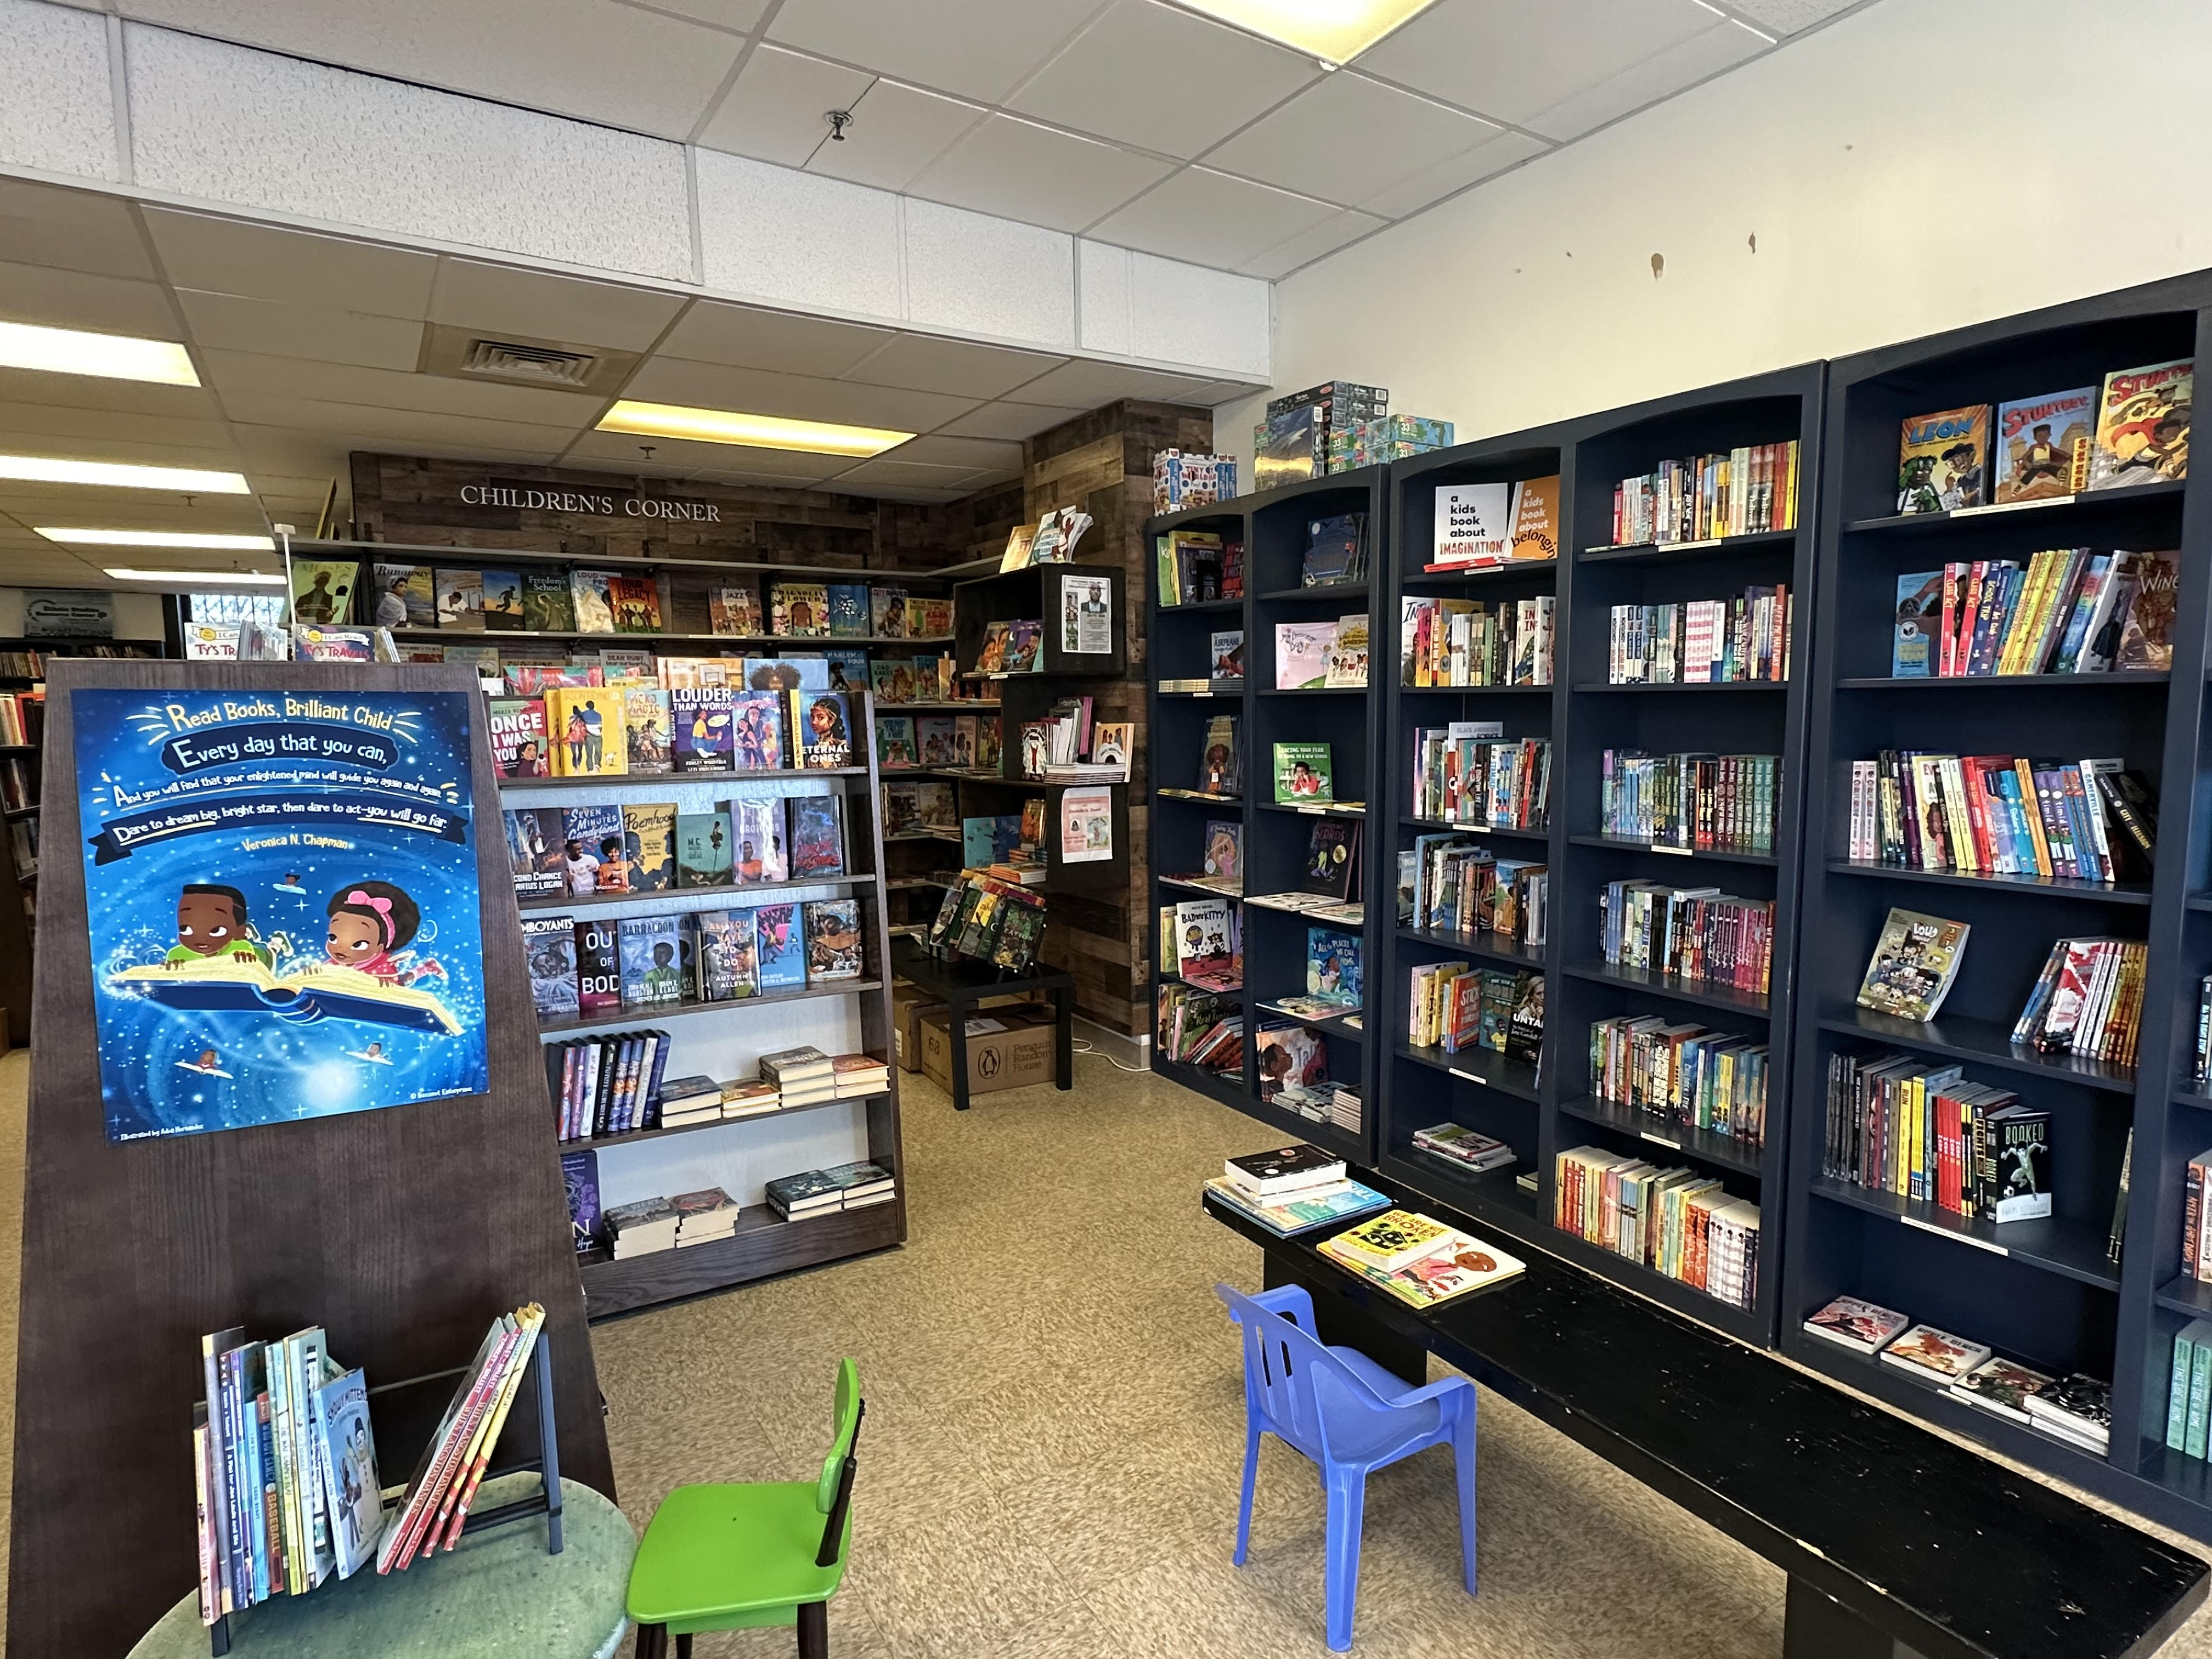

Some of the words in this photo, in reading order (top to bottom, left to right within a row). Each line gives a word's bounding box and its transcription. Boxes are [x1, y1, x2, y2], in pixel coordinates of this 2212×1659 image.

[1401, 423, 1410, 432] 33
[1908, 416, 1974, 445] LEON
[1333, 438, 1341, 448] 33
[1331, 463, 1340, 472] 33
[460, 485, 613, 515] CHILDREN'S
[625, 499, 721, 523] CORNER
[1451, 504, 1476, 514] kids
[1523, 497, 1544, 509] kids
[1450, 516, 1480, 526] book
[1521, 508, 1545, 520] book
[1450, 528, 1486, 538] about
[1519, 520, 1549, 532] about
[376, 565, 431, 578] Runaway
[533, 583, 562, 591] School
[620, 578, 643, 589] YOUR
[617, 588, 651, 603] LEGACY
[1983, 580, 1996, 603] SCHOOL
[1944, 597, 1954, 609] ACT
[1967, 597, 1976, 609] ACT
[1980, 605, 1991, 621] TRIP
[329, 645, 370, 658] TRAVELS
[672, 689, 732, 702] LOUDER
[673, 703, 698, 711] THAN
[699, 702, 732, 711] WORDS
[166, 704, 222, 731] Read
[223, 699, 280, 720] Books,
[285, 698, 348, 720] Brilliant
[354, 707, 393, 730] Child
[491, 713, 543, 733] ONCE
[493, 734, 499, 748] I
[502, 731, 531, 747] WAS
[171, 738, 238, 768] Every
[244, 736, 275, 755] day
[279, 733, 318, 751] that
[321, 740, 353, 756] you
[357, 745, 387, 764] can,
[494, 747, 517, 762] YOU
[802, 744, 850, 755] ETERNAL
[810, 753, 842, 763] ONES
[113, 785, 140, 807] And
[142, 789, 160, 802] you
[162, 782, 179, 794] will
[180, 778, 200, 792] find
[200, 776, 222, 788] that
[224, 775, 244, 786] your
[247, 770, 297, 782] enlightened
[299, 770, 319, 780] mind
[321, 771, 337, 781] will
[339, 773, 362, 782] guide
[364, 776, 379, 785] you
[380, 777, 402, 789] again
[403, 782, 419, 792] and
[2084, 774, 2100, 816] GAMERVILLE
[571, 808, 601, 823] SEVEN
[2042, 800, 2055, 822] timid
[2056, 801, 2068, 824] timid
[112, 826, 149, 842] Dare
[149, 820, 163, 830] to
[165, 812, 199, 825] dream
[200, 809, 221, 820] big,
[222, 804, 255, 818] bright
[257, 803, 280, 814] star,
[282, 802, 304, 812] then
[307, 802, 330, 812] dare
[332, 803, 344, 812] to
[391, 809, 411, 821] will
[413, 814, 427, 824] go
[430, 815, 447, 828] far.
[577, 814, 617, 832] MINUTES
[624, 808, 675, 831] Poemhood
[567, 822, 620, 842] Candyland
[242, 836, 287, 851] Veronica
[290, 833, 300, 845] N.
[303, 833, 348, 849] Chapman
[1181, 913, 1196, 923] BAD
[1203, 910, 1226, 921] KITTY
[622, 921, 674, 936] BARRACOON
[1914, 923, 1938, 938] LOUD
[1318, 941, 1328, 953] ALL
[600, 957, 613, 967] OF
[715, 974, 748, 982] AUTUMN
[1013, 1039, 1053, 1054] Penguin
[1013, 1061, 1042, 1072] House
[2005, 1122, 2044, 1146] BOOKED
[1383, 1215, 1440, 1238] BROKEN
[1409, 1218, 1429, 1227] ARE
[2175, 1367, 2185, 1383] THIS
[2194, 1372, 2204, 1387] THIS
[455, 1406, 472, 1431] WHEN
[470, 1402, 486, 1429] WHEN
[427, 1431, 460, 1482] LANGSTON
[445, 1427, 473, 1476] LANGSTON
[411, 1482, 431, 1515] DANCES
[428, 1475, 449, 1509] DANCES
[267, 1493, 280, 1554] BASEBALL
